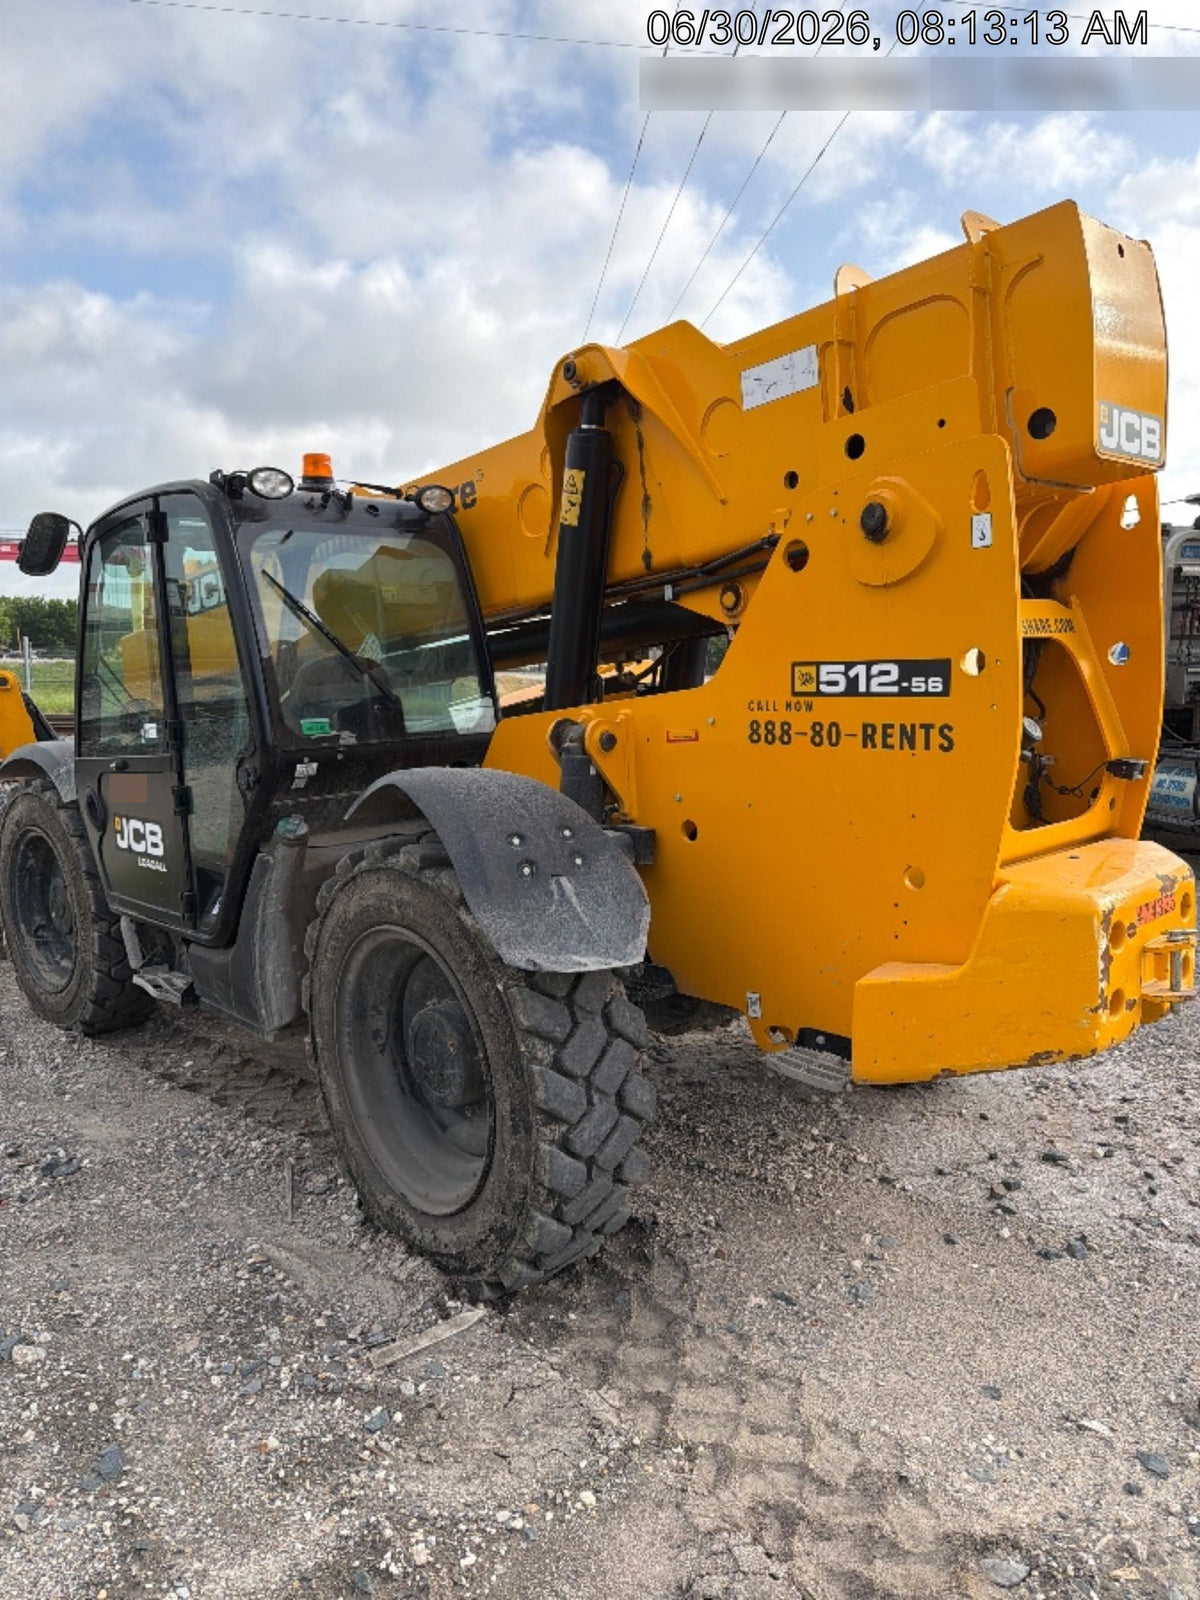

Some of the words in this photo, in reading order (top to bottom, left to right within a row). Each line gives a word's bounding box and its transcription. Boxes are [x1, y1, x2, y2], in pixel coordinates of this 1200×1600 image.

[1100, 408, 1160, 460] JCB
[818, 662, 943, 694] 512-56
[748, 700, 779, 712] CALL
[785, 701, 814, 712] NOW
[748, 719, 955, 753] 888-80-RENTS
[116, 817, 164, 857] JCB
